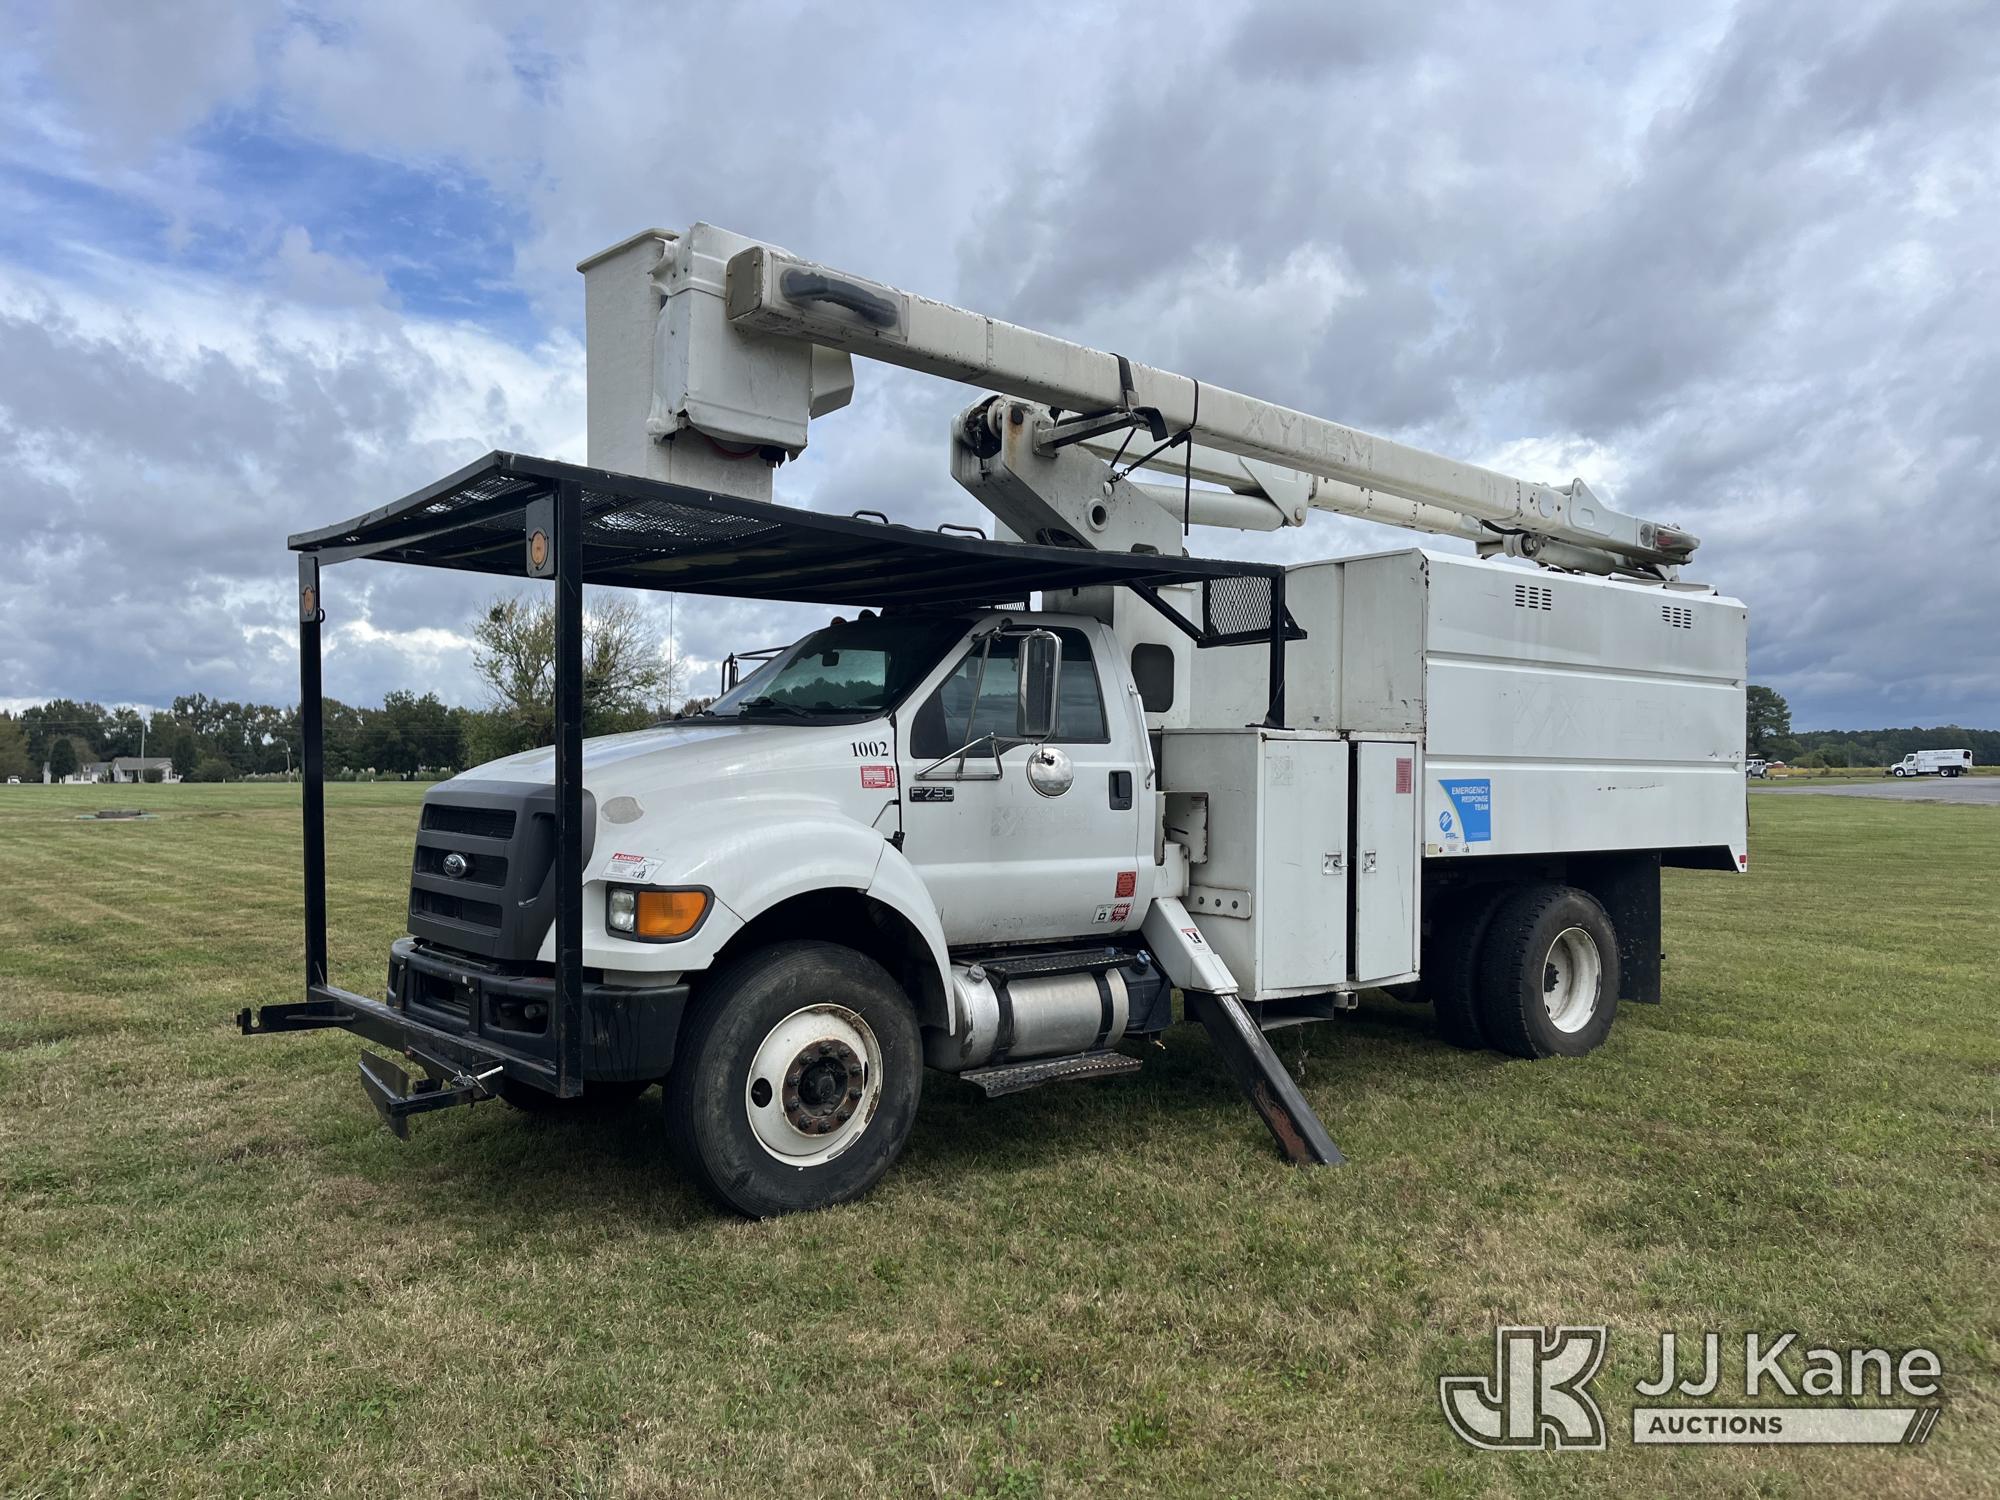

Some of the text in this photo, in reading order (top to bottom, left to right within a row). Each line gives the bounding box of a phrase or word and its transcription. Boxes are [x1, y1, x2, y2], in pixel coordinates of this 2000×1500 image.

[851, 741, 889, 757] 1002
[1451, 786, 1489, 795] EMERGENCY
[1461, 795, 1489, 803] RESPONSE
[1474, 803, 1489, 811] TEAM
